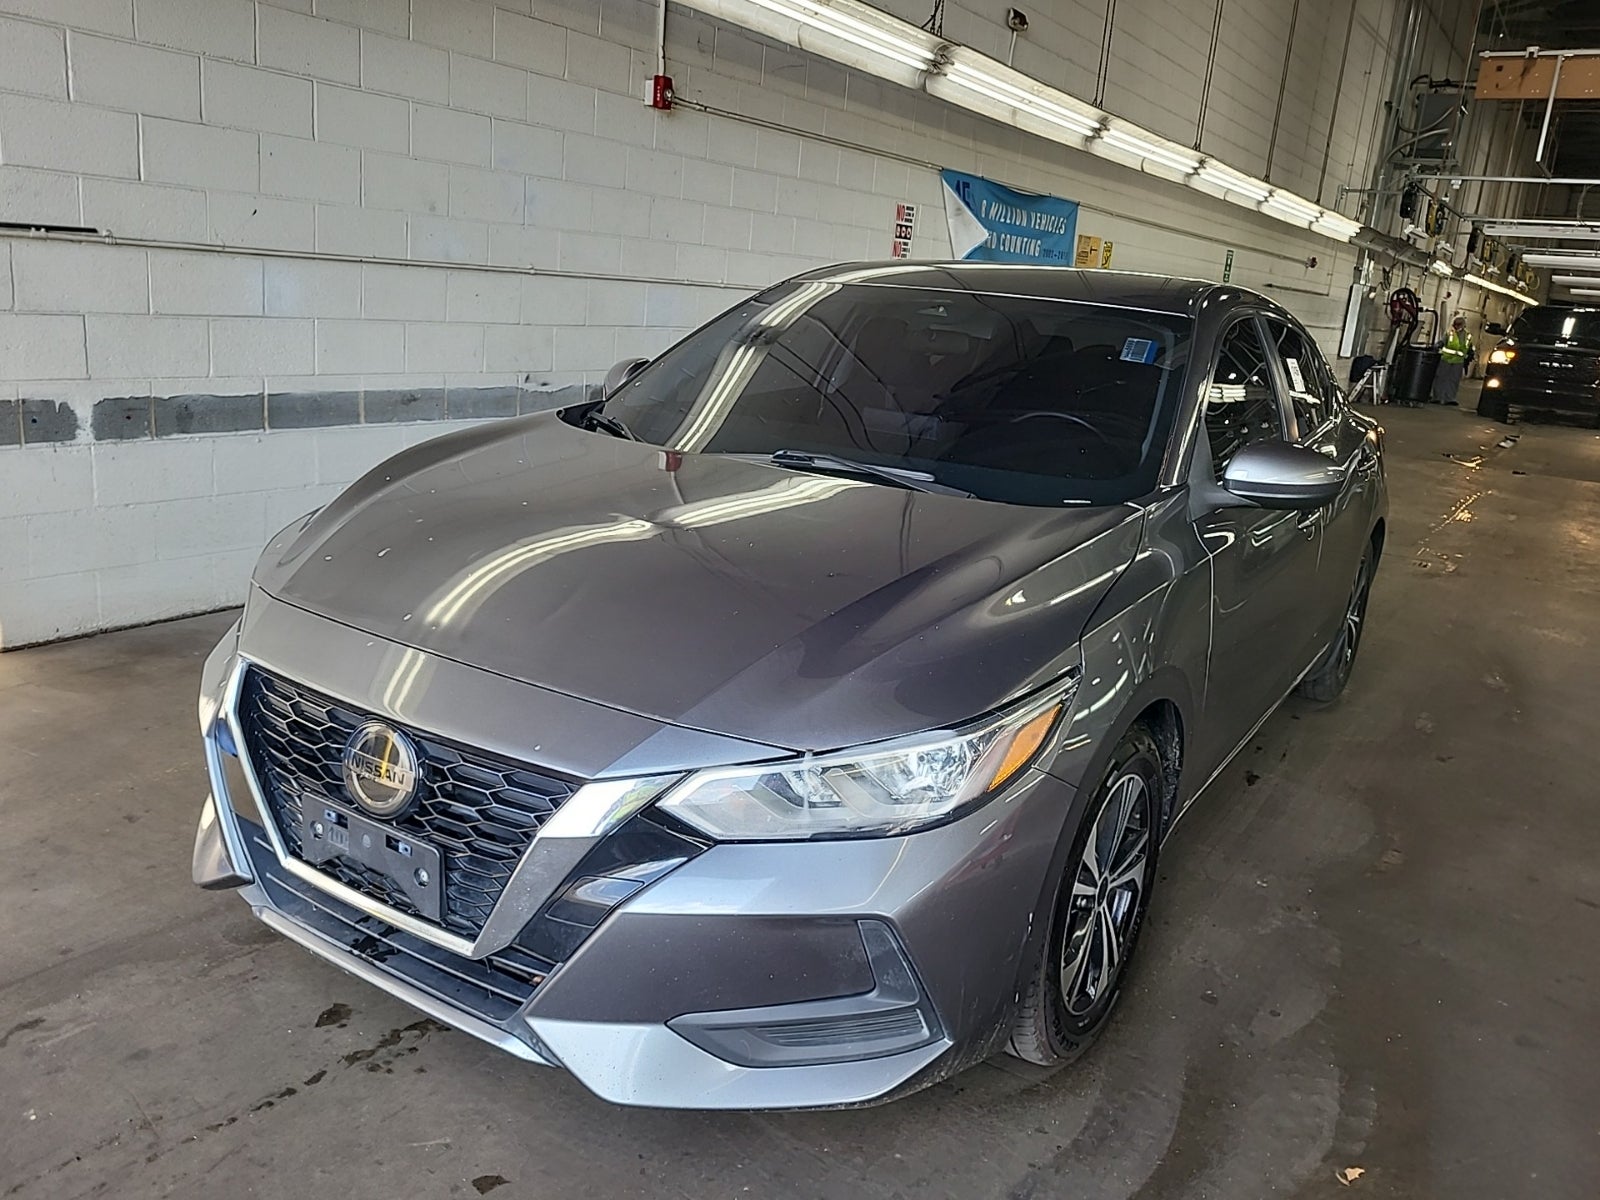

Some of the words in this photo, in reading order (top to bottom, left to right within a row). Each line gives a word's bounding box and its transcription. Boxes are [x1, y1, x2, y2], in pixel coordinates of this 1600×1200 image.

[896, 203, 905, 222] NO
[989, 201, 1027, 227] MILLION
[1031, 211, 1067, 235] VEHICLES
[892, 241, 902, 258] NO
[985, 230, 997, 249] ND
[1000, 233, 1042, 257] COUNTING
[351, 756, 405, 785] NISSAN
